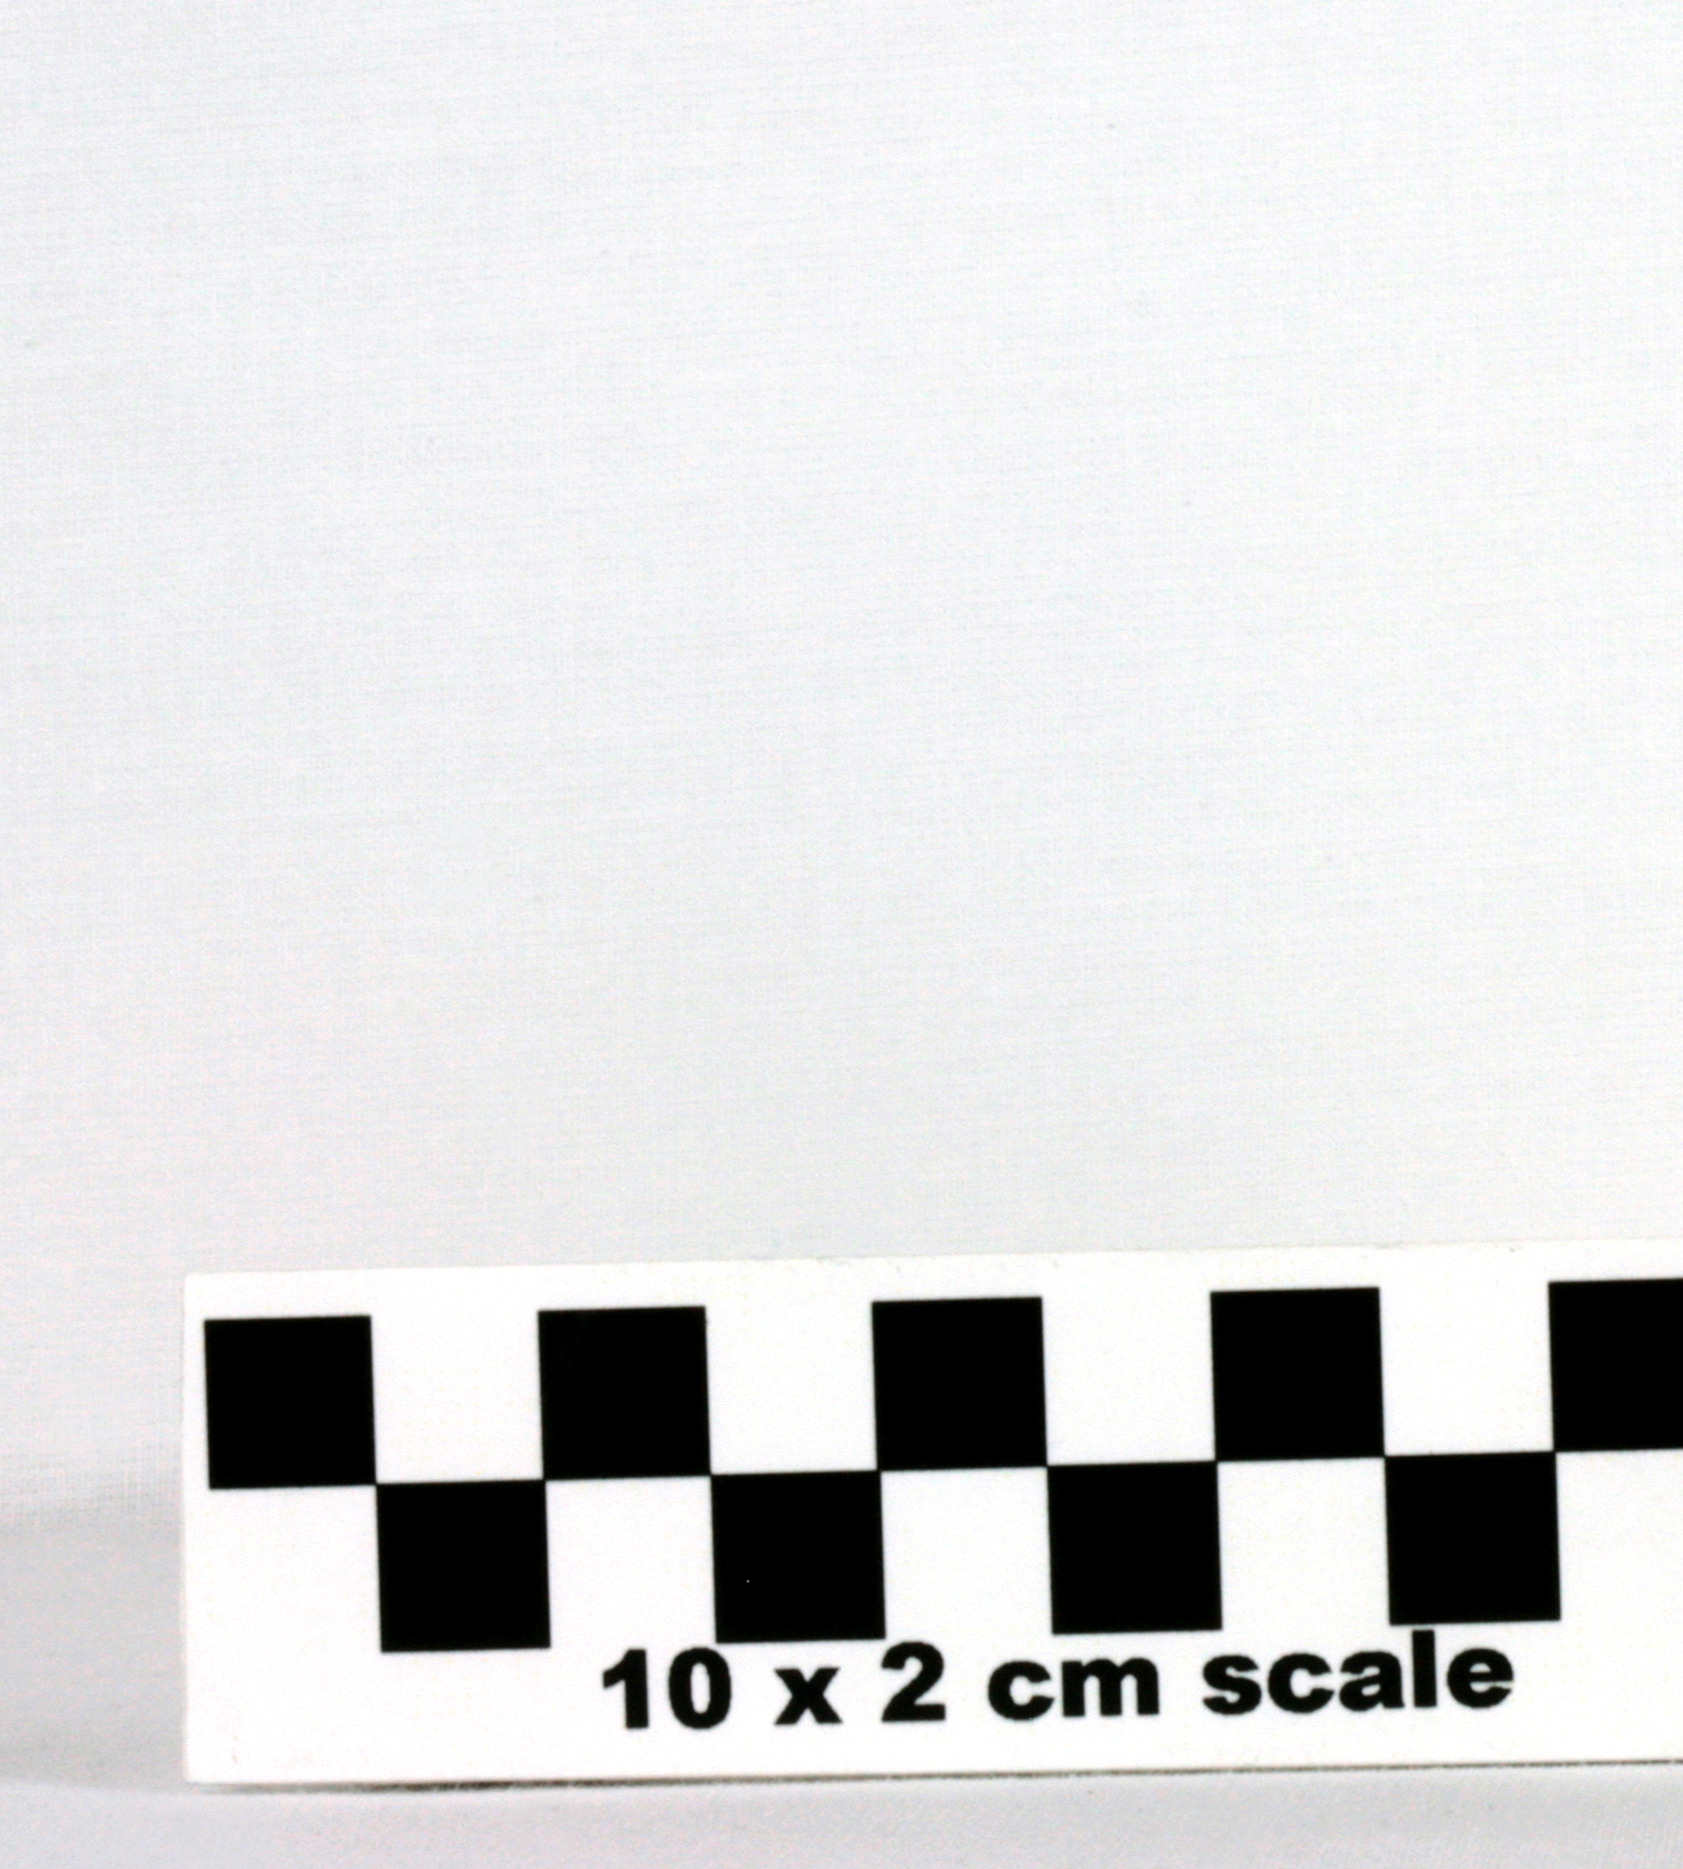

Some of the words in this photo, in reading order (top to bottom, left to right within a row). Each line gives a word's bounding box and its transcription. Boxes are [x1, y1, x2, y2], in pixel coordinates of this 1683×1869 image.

[602, 1647, 732, 1730] 10
[775, 1667, 842, 1726] x
[881, 1641, 946, 1723] 2
[987, 1657, 1160, 1721] cm
[1202, 1629, 1514, 1716] scale
